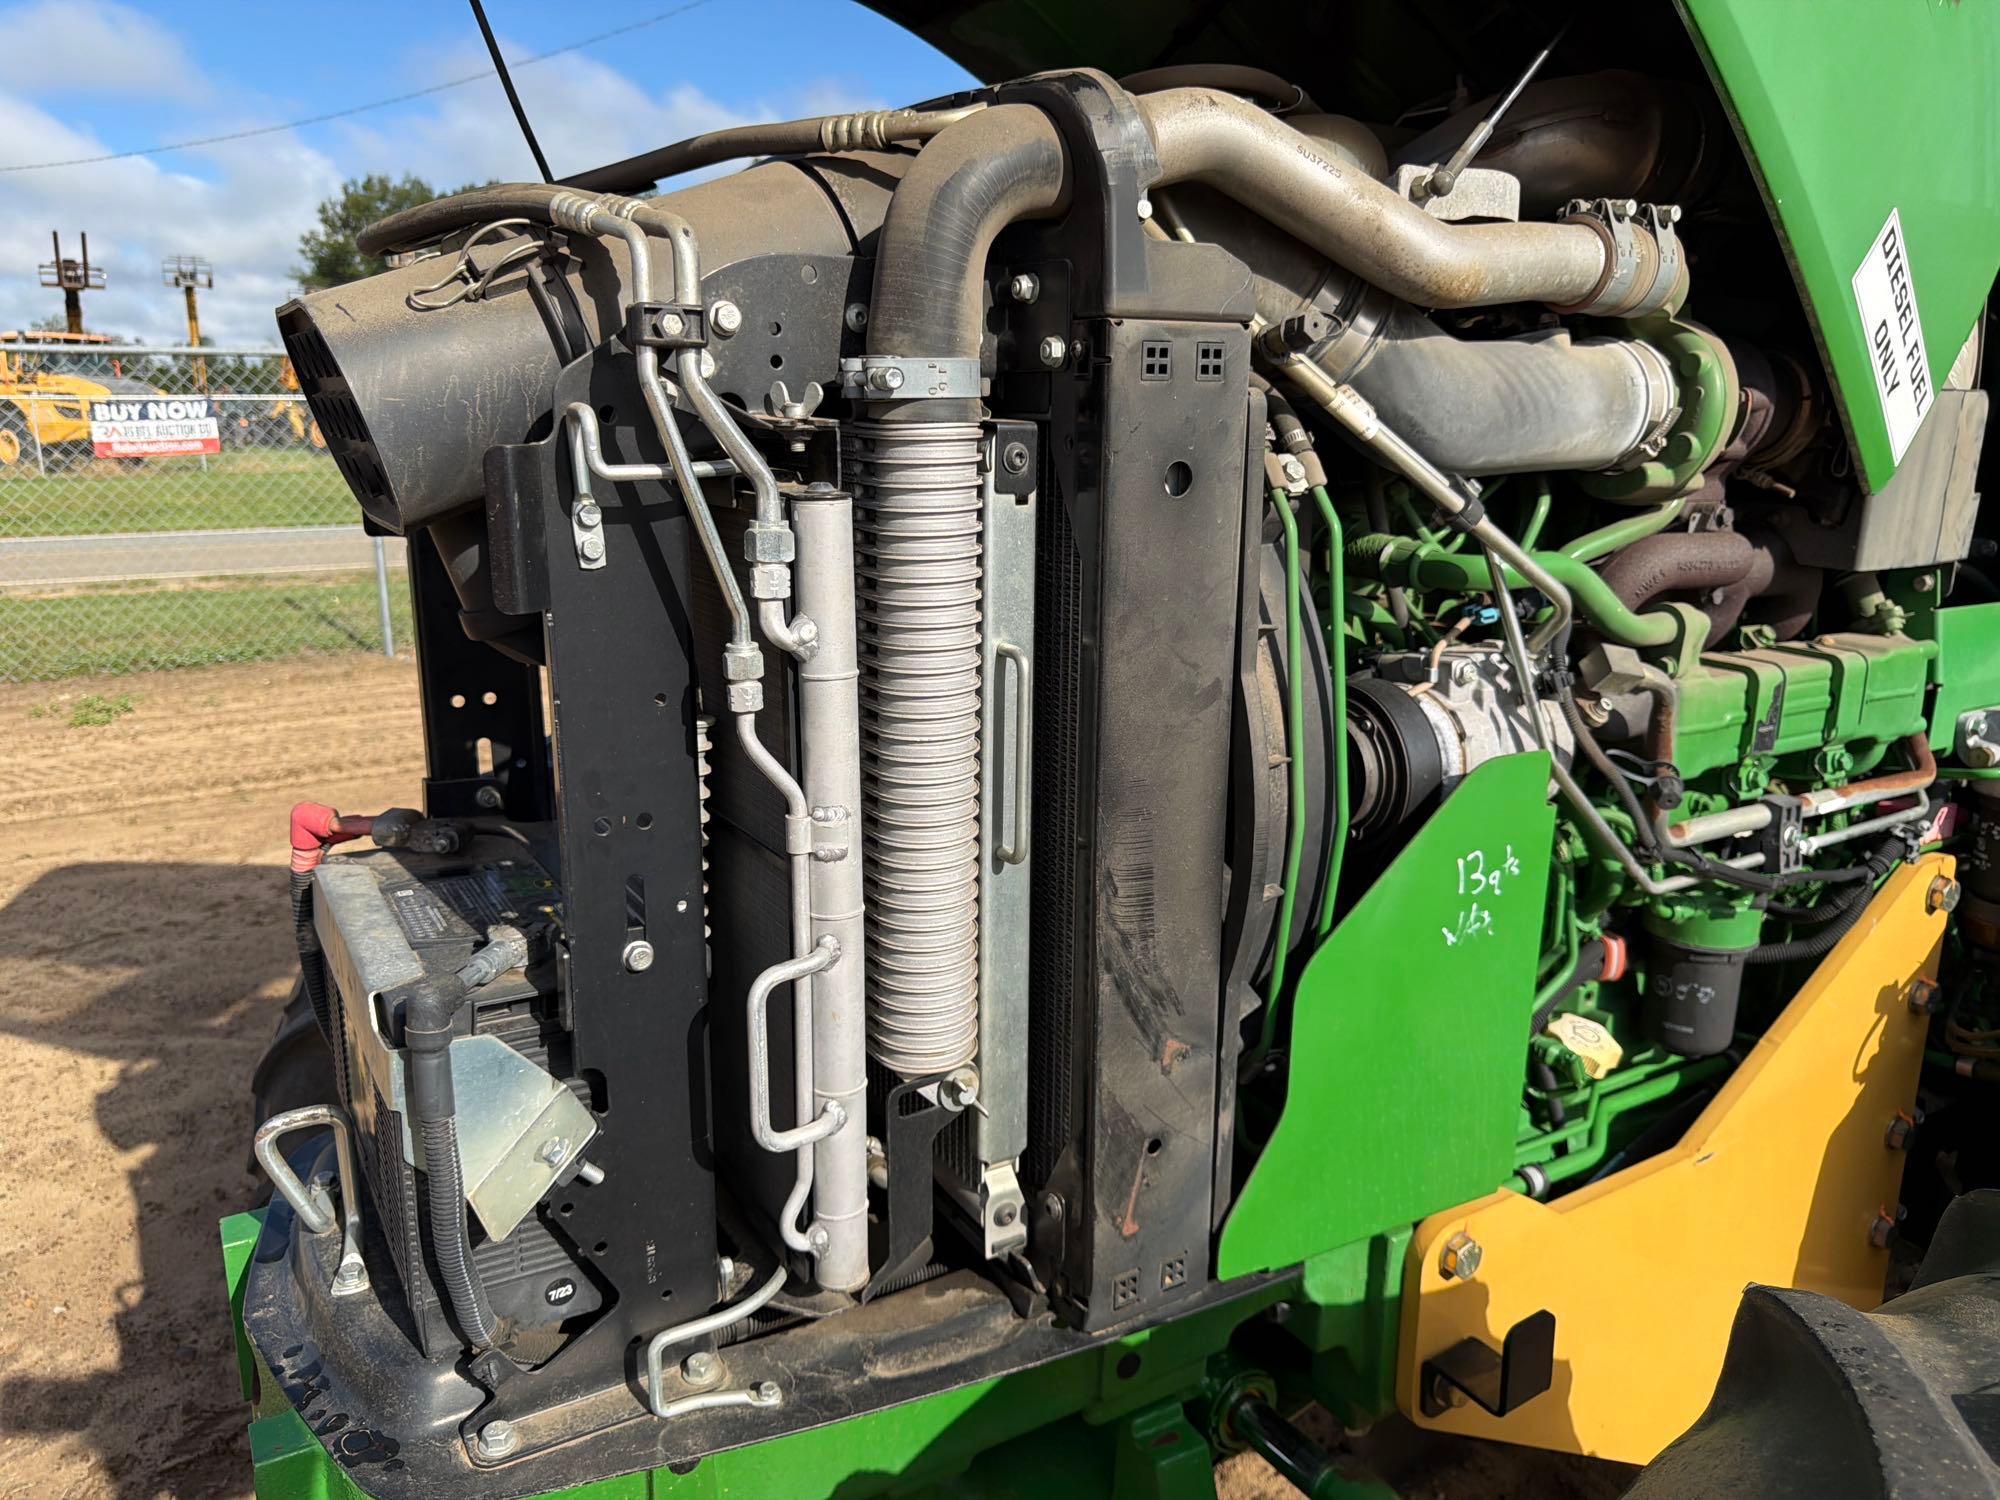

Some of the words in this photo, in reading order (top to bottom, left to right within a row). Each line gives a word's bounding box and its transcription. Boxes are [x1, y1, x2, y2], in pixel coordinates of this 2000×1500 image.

[1296, 144, 1343, 178] SU37225
[1882, 226, 1914, 347] DIESEL
[1907, 339, 1928, 417] FUEL
[1874, 319, 1900, 398] ONLY
[93, 402, 142, 421] BUY
[147, 400, 208, 420] NOW
[155, 423, 197, 438] AUCTION
[548, 1284, 574, 1302] 7/23
